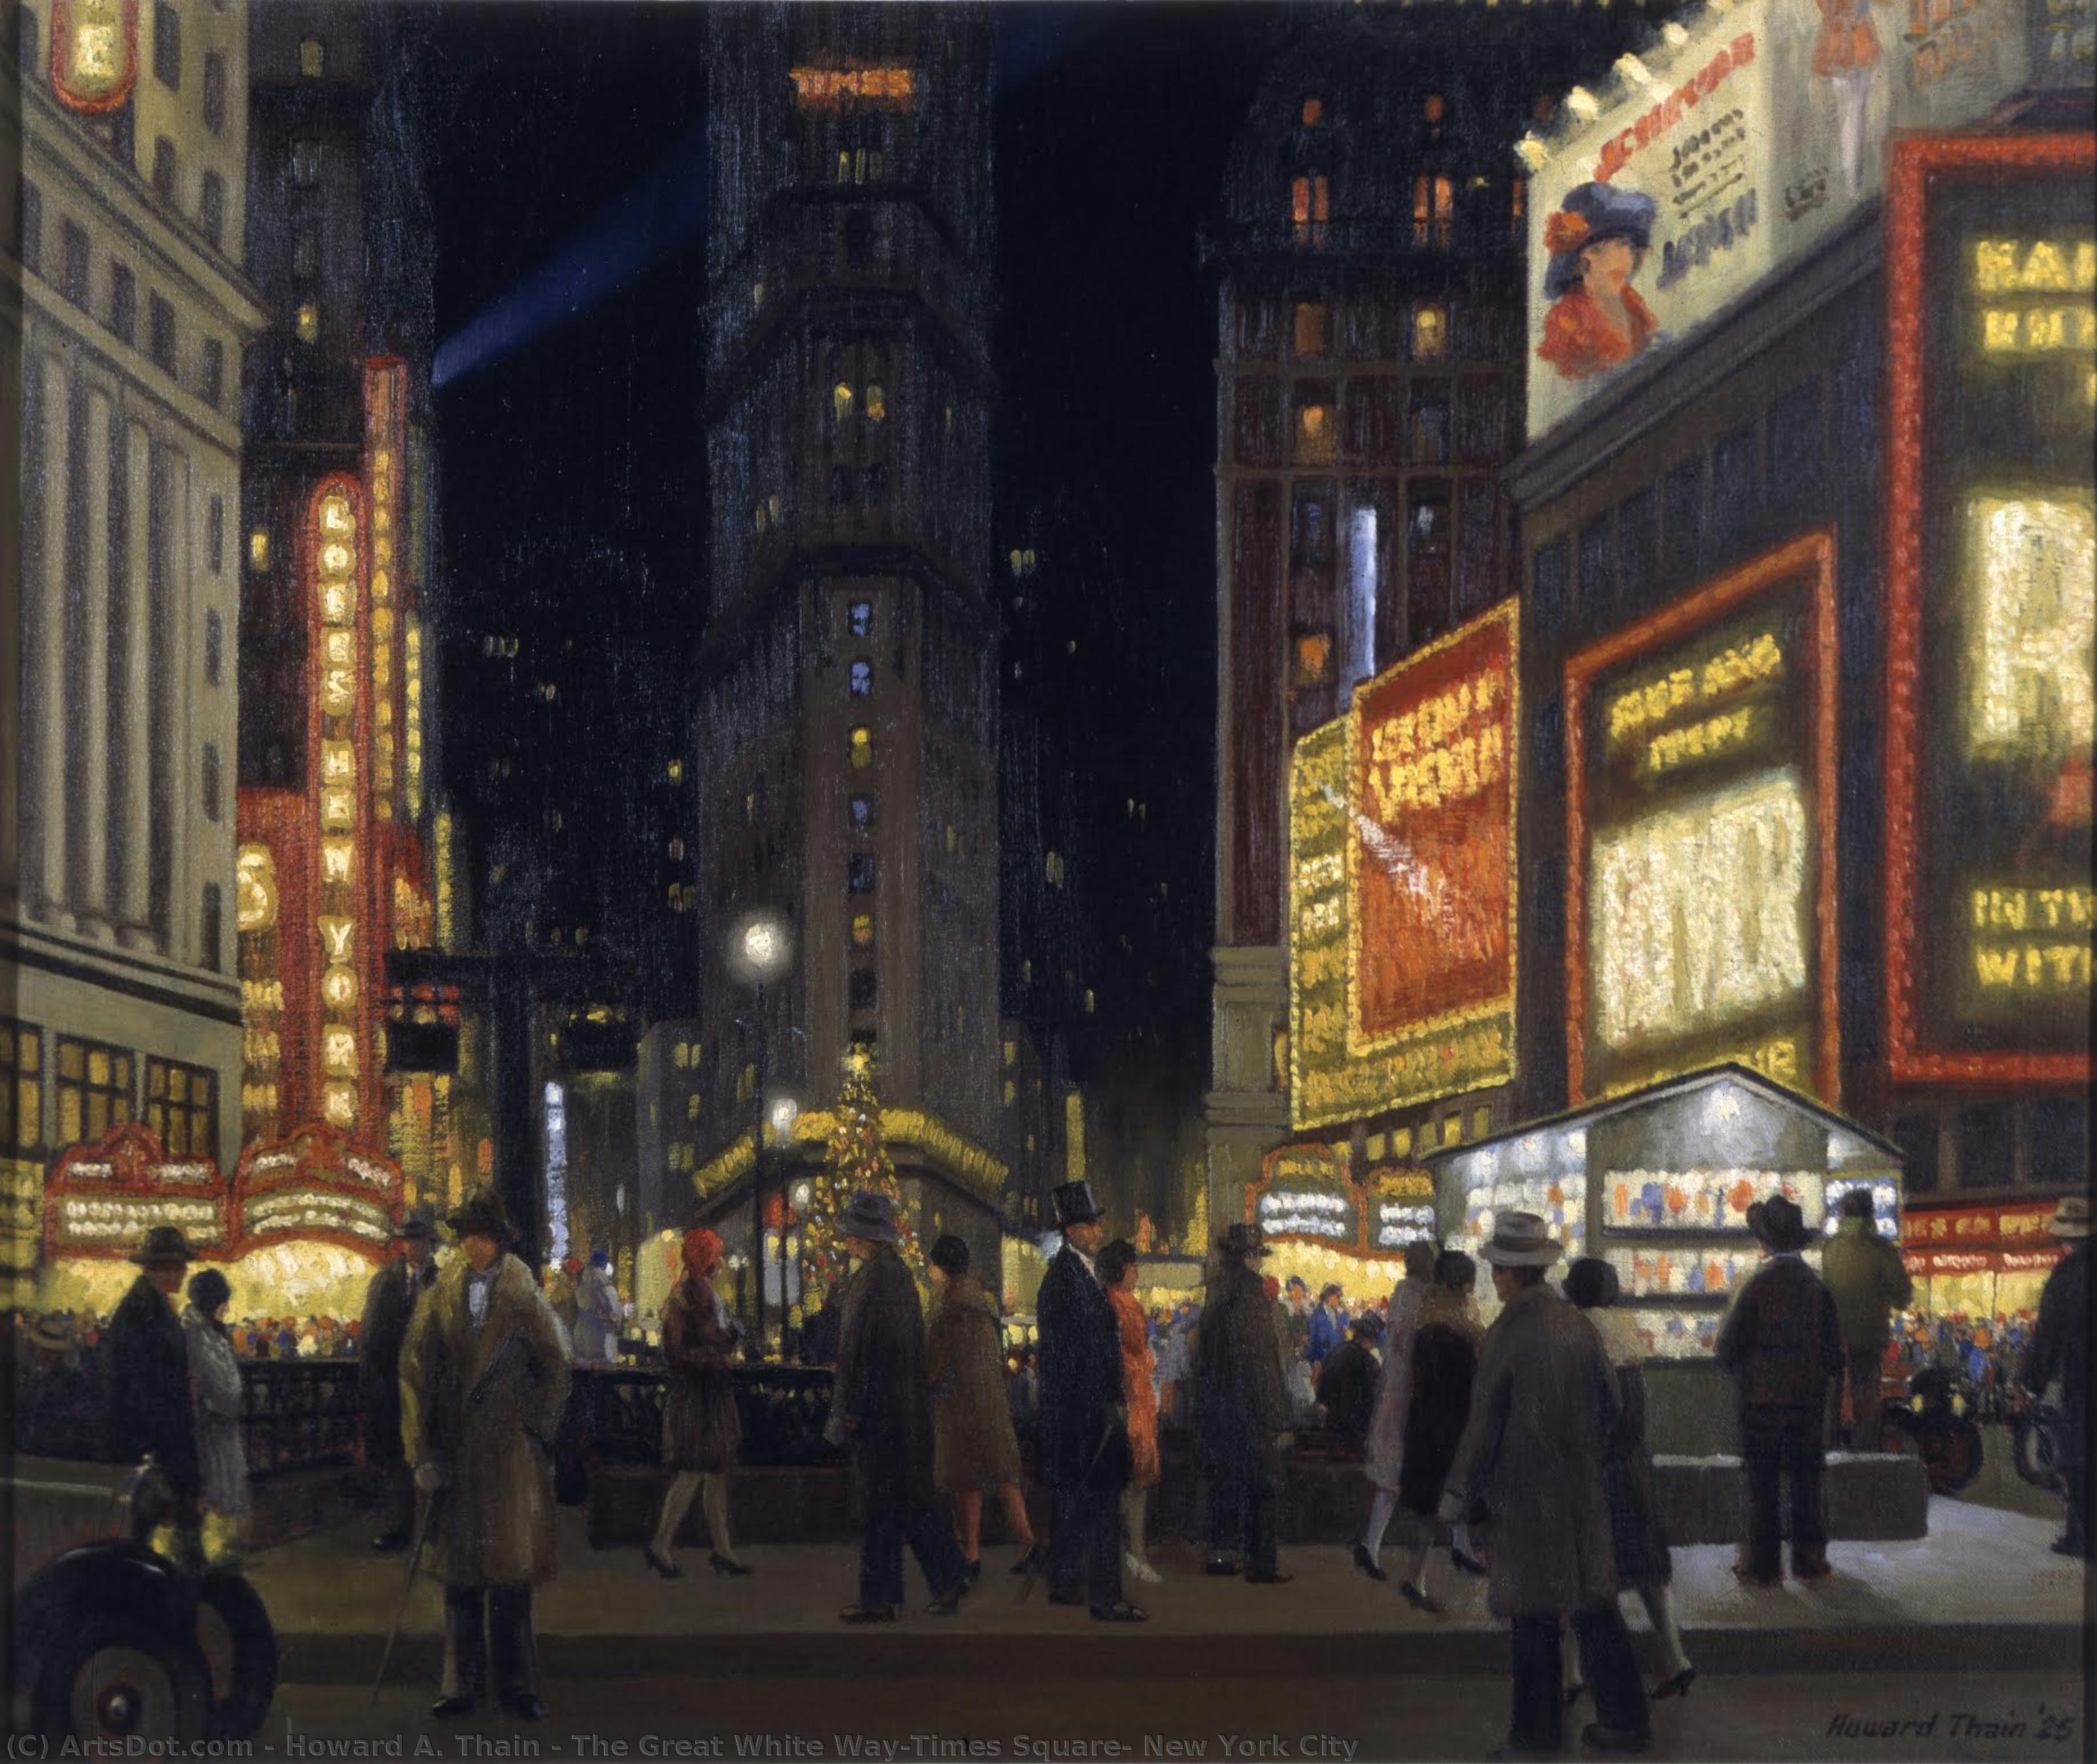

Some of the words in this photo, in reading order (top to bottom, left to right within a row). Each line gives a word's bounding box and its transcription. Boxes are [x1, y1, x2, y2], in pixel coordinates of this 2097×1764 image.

[322, 917, 356, 1121] YORK
[1825, 1712, 1938, 1738] Howard
[1949, 1708, 2027, 1739] Thain
